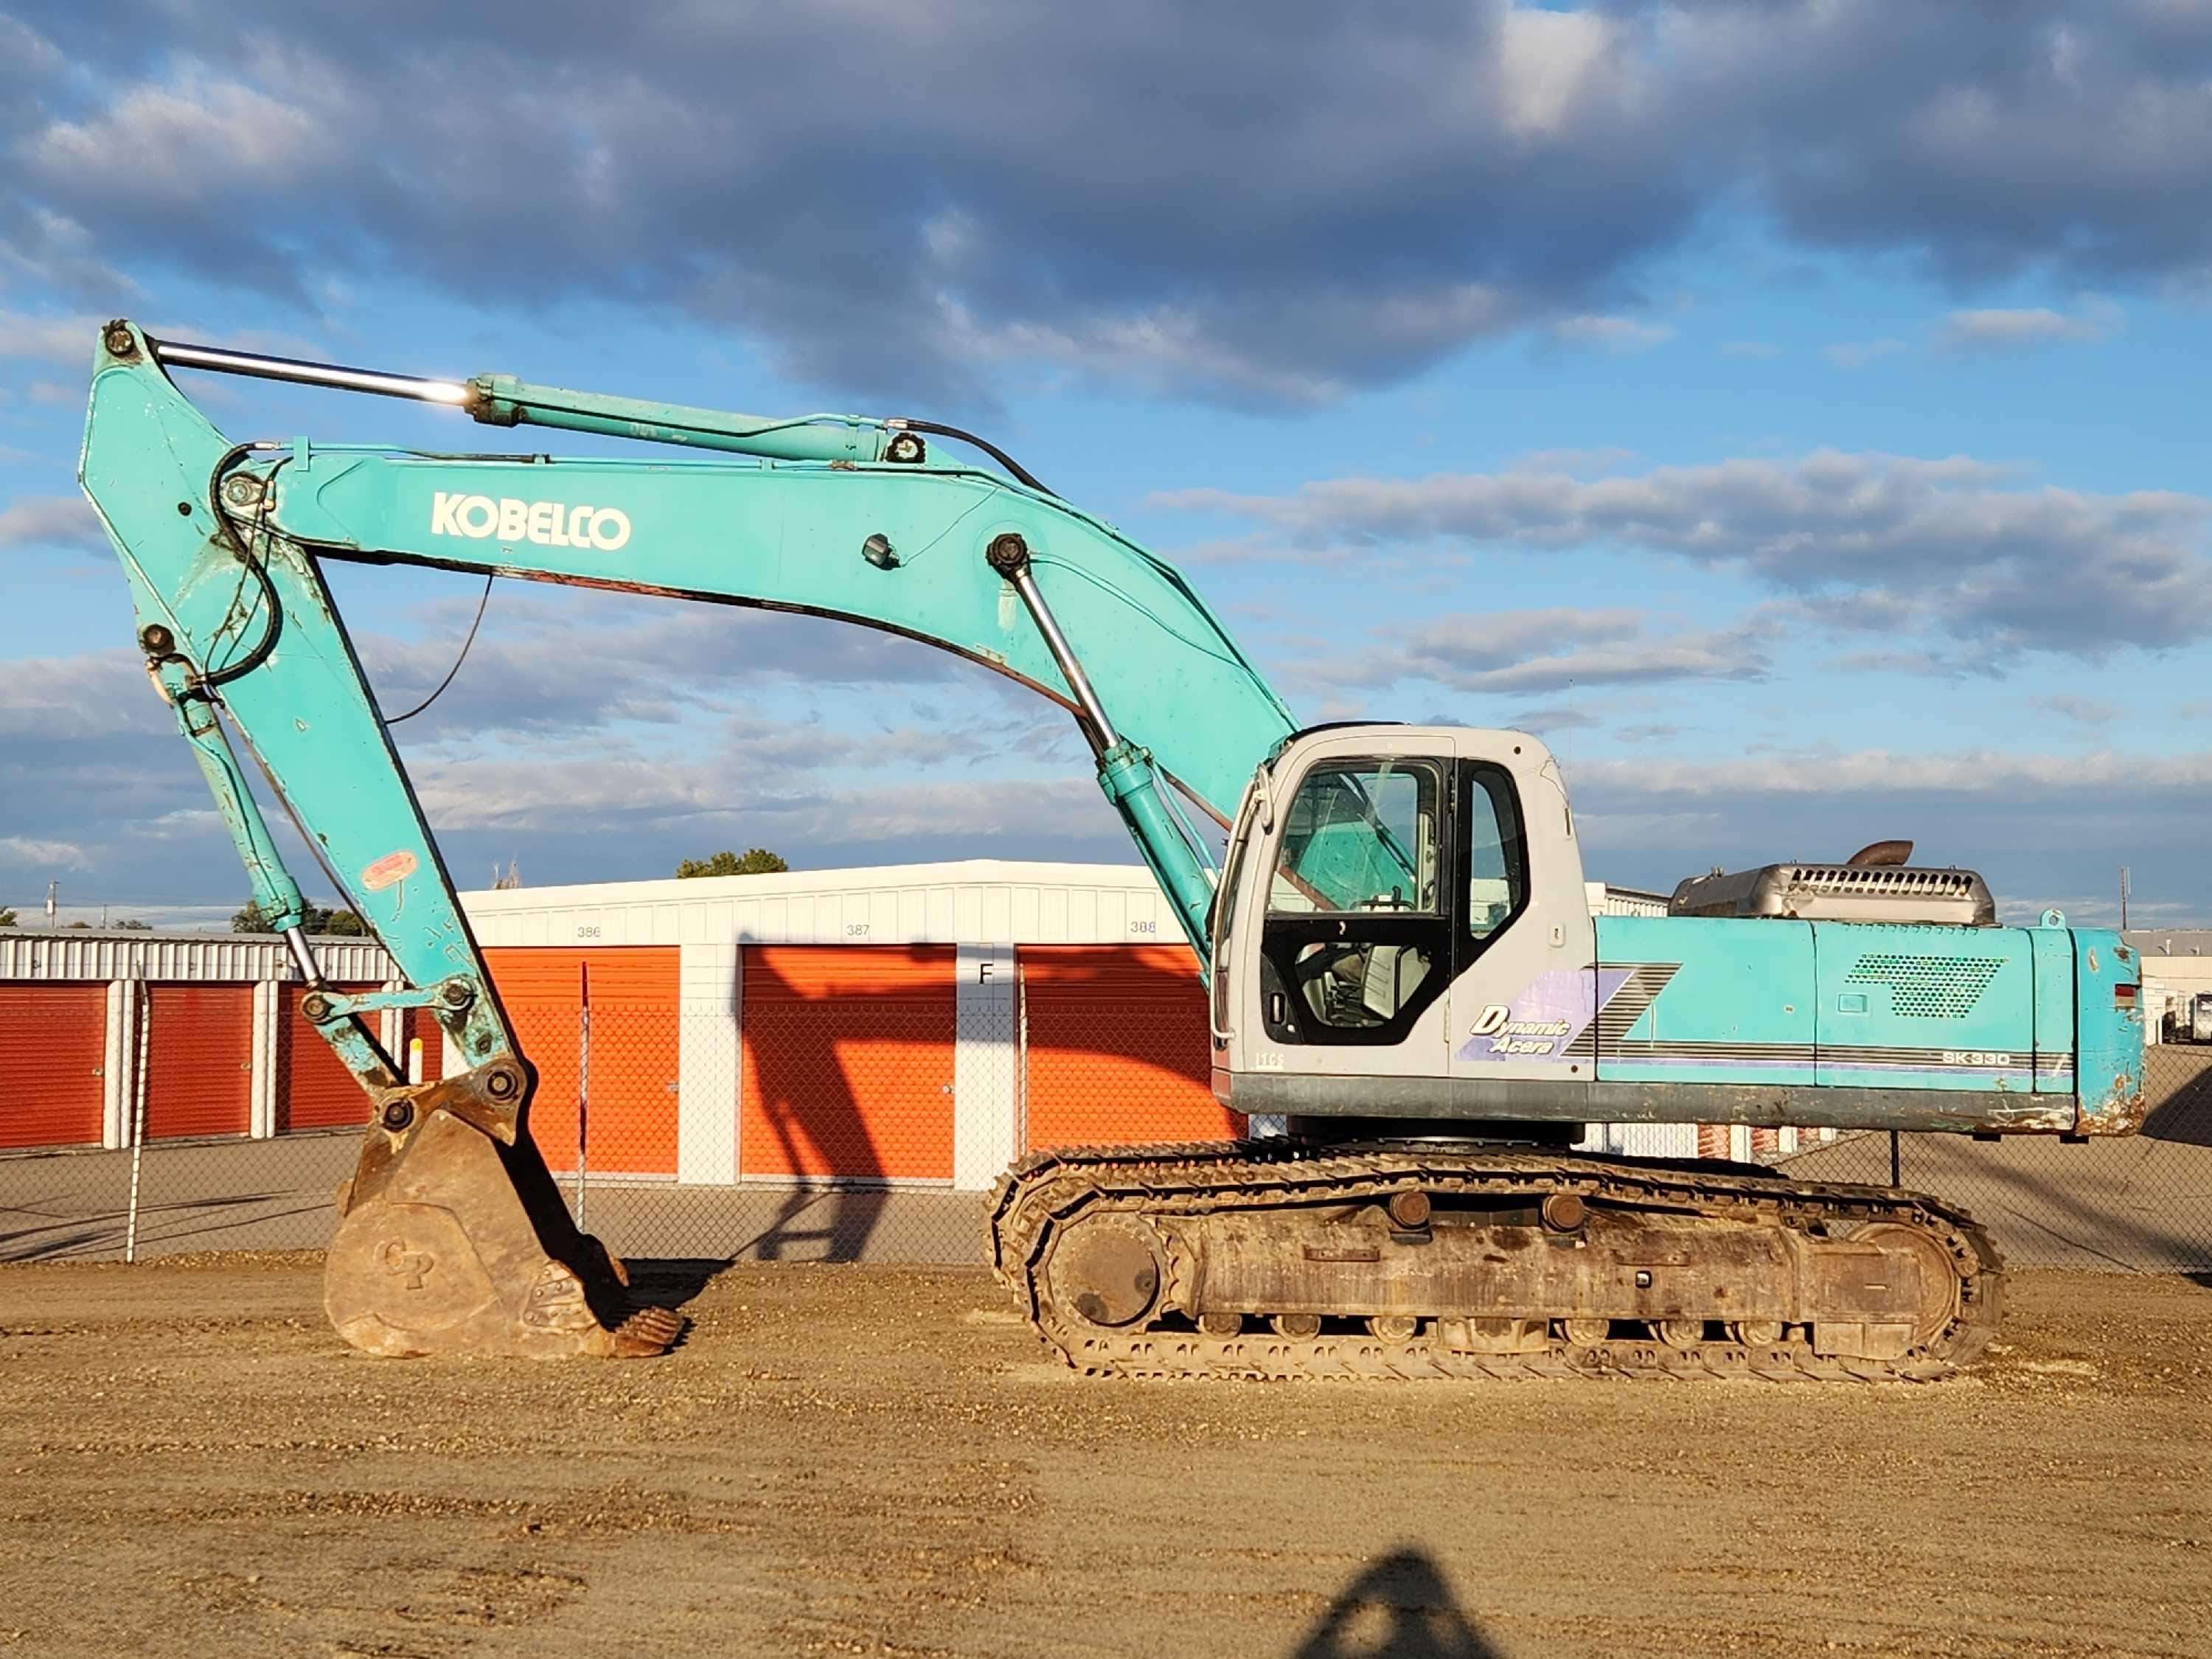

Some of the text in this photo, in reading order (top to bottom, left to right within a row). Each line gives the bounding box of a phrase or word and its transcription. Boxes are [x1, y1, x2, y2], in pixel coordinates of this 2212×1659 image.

[431, 492, 631, 551] KOBELCO
[846, 925, 870, 936] 387
[980, 963, 994, 984] F
[1470, 1004, 1571, 1038] Dynamic
[1488, 1037, 1554, 1054] Acera
